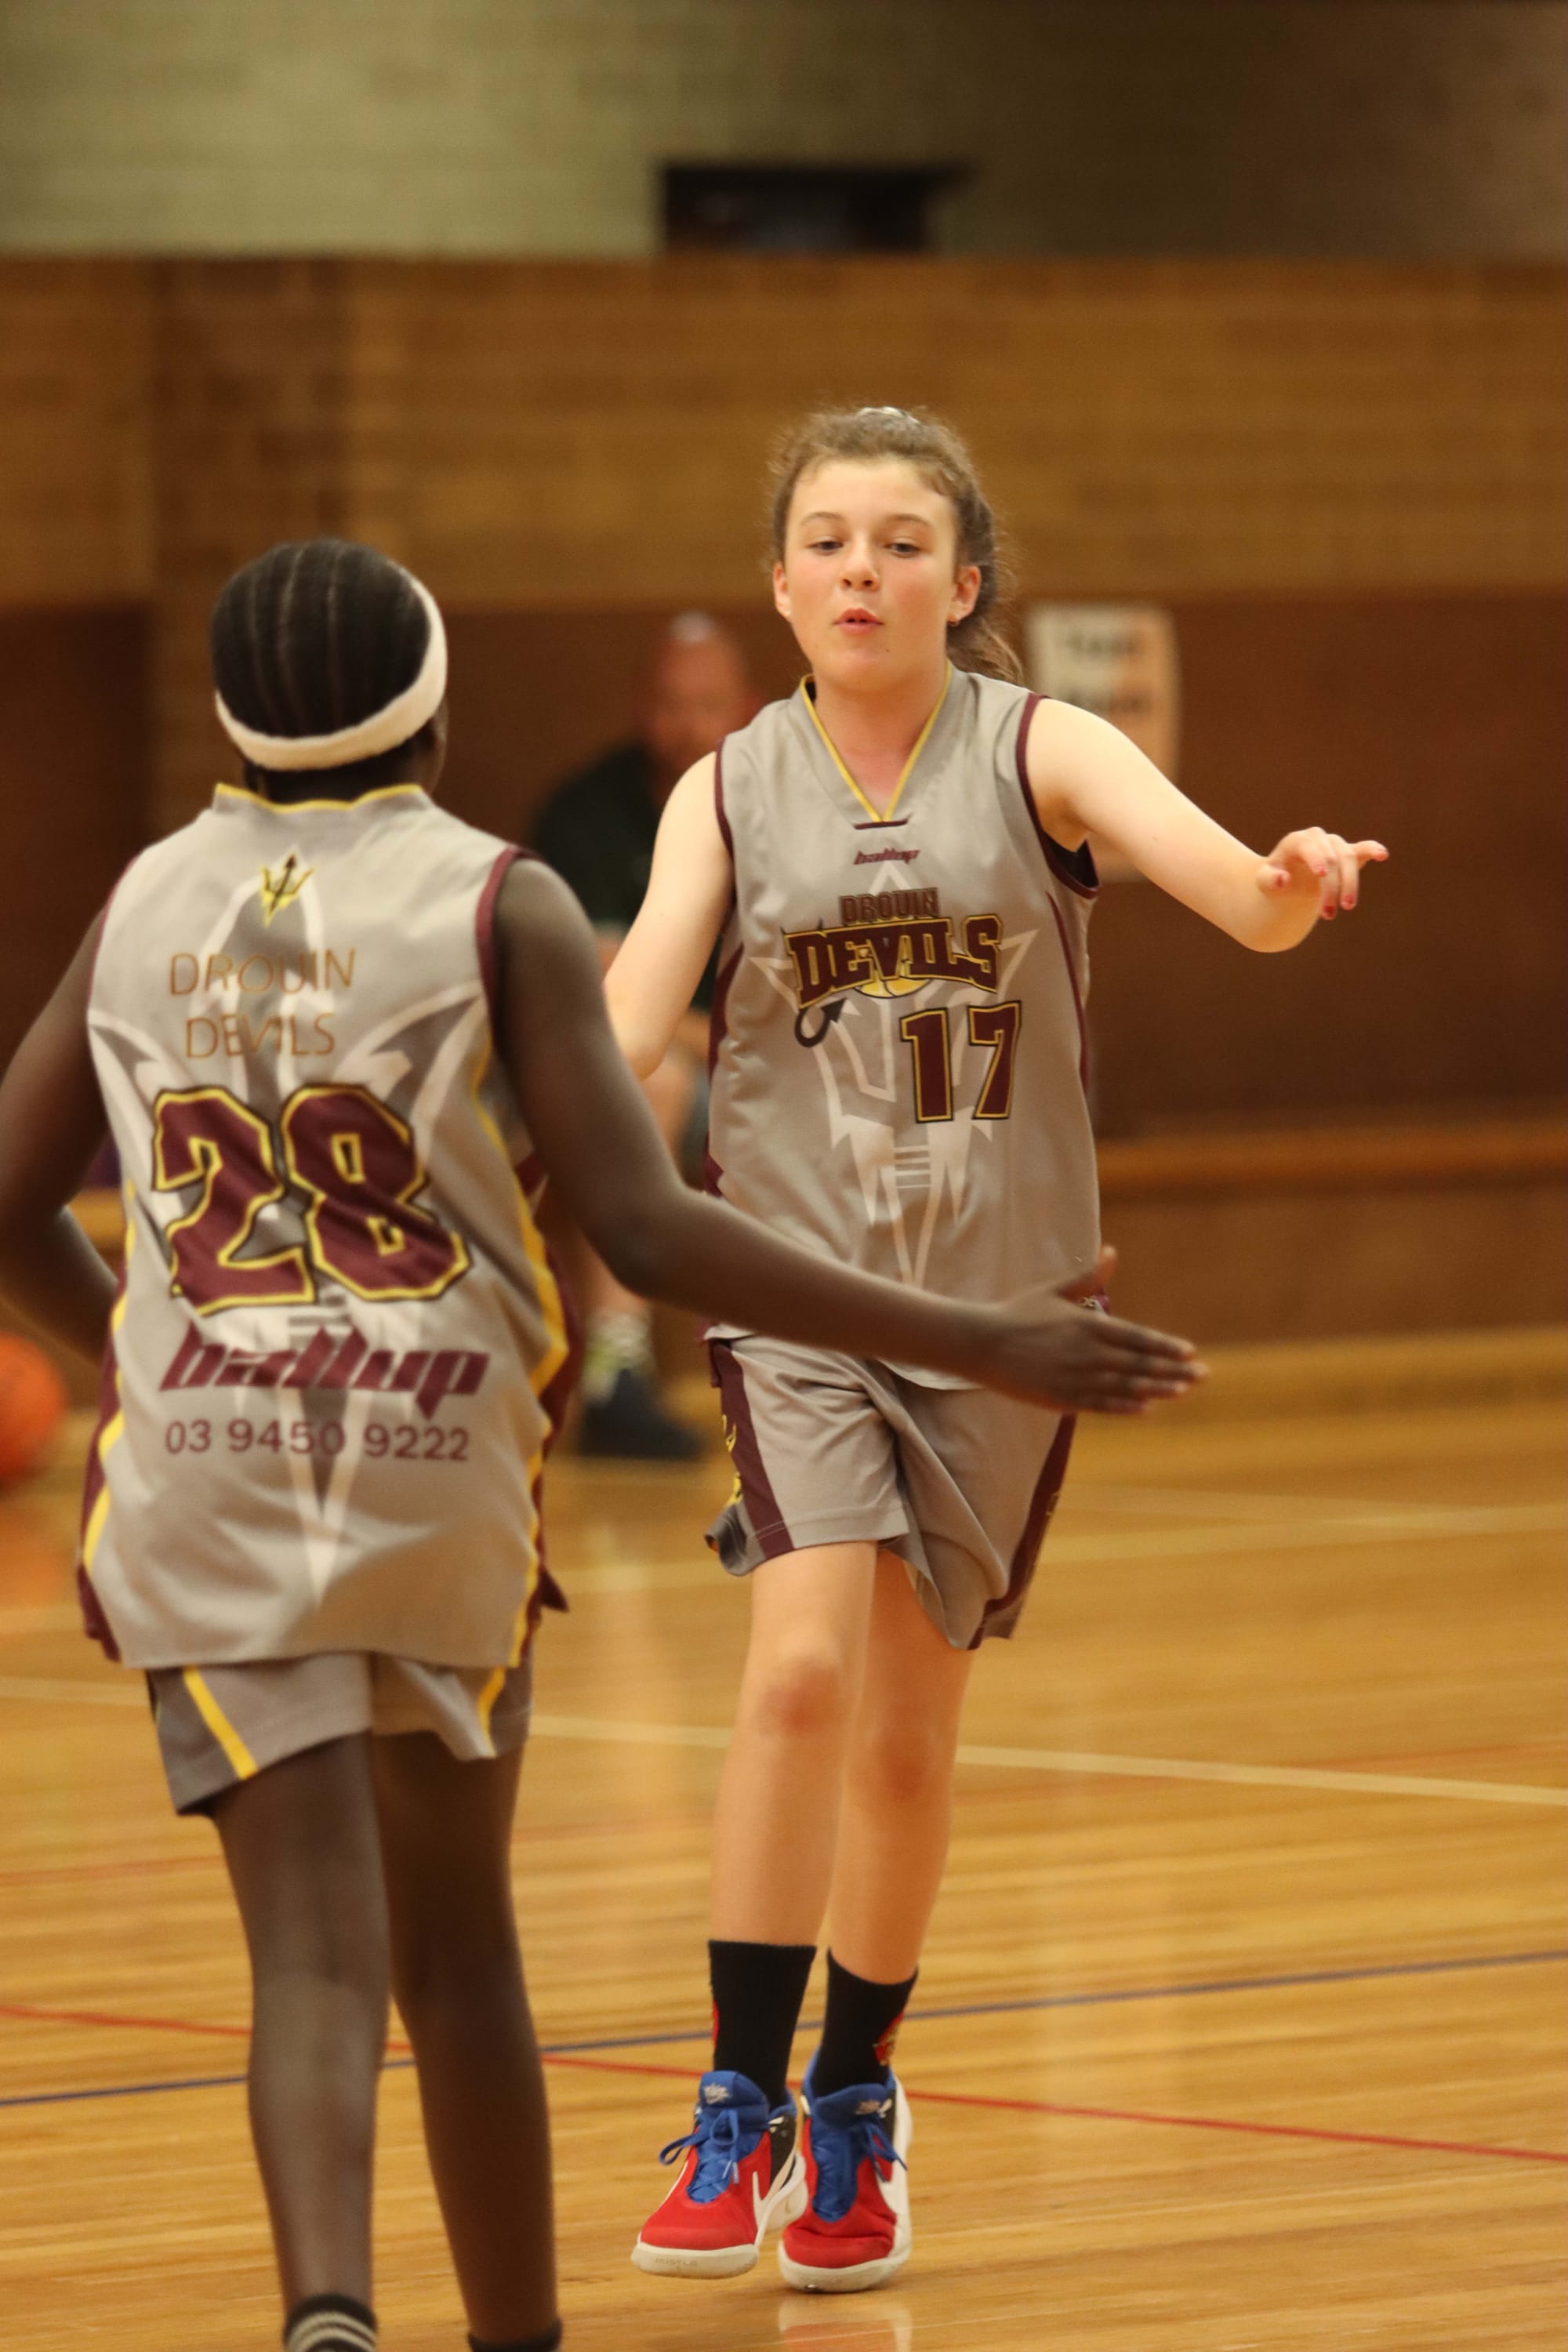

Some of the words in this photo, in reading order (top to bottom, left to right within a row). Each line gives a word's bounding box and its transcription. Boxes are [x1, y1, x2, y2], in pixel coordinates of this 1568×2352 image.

[839, 887, 939, 925] DROUIN
[169, 947, 357, 996] DROUIN
[784, 914, 1004, 1009] DEVILS
[185, 1013, 336, 1059] DEVILS
[900, 1000, 1022, 1123] 17
[152, 1083, 472, 1317] 28
[160, 1322, 491, 1421] ballup
[165, 1420, 212, 1454] 03
[227, 1420, 347, 1456] 9450
[364, 1424, 470, 1462] 9222
